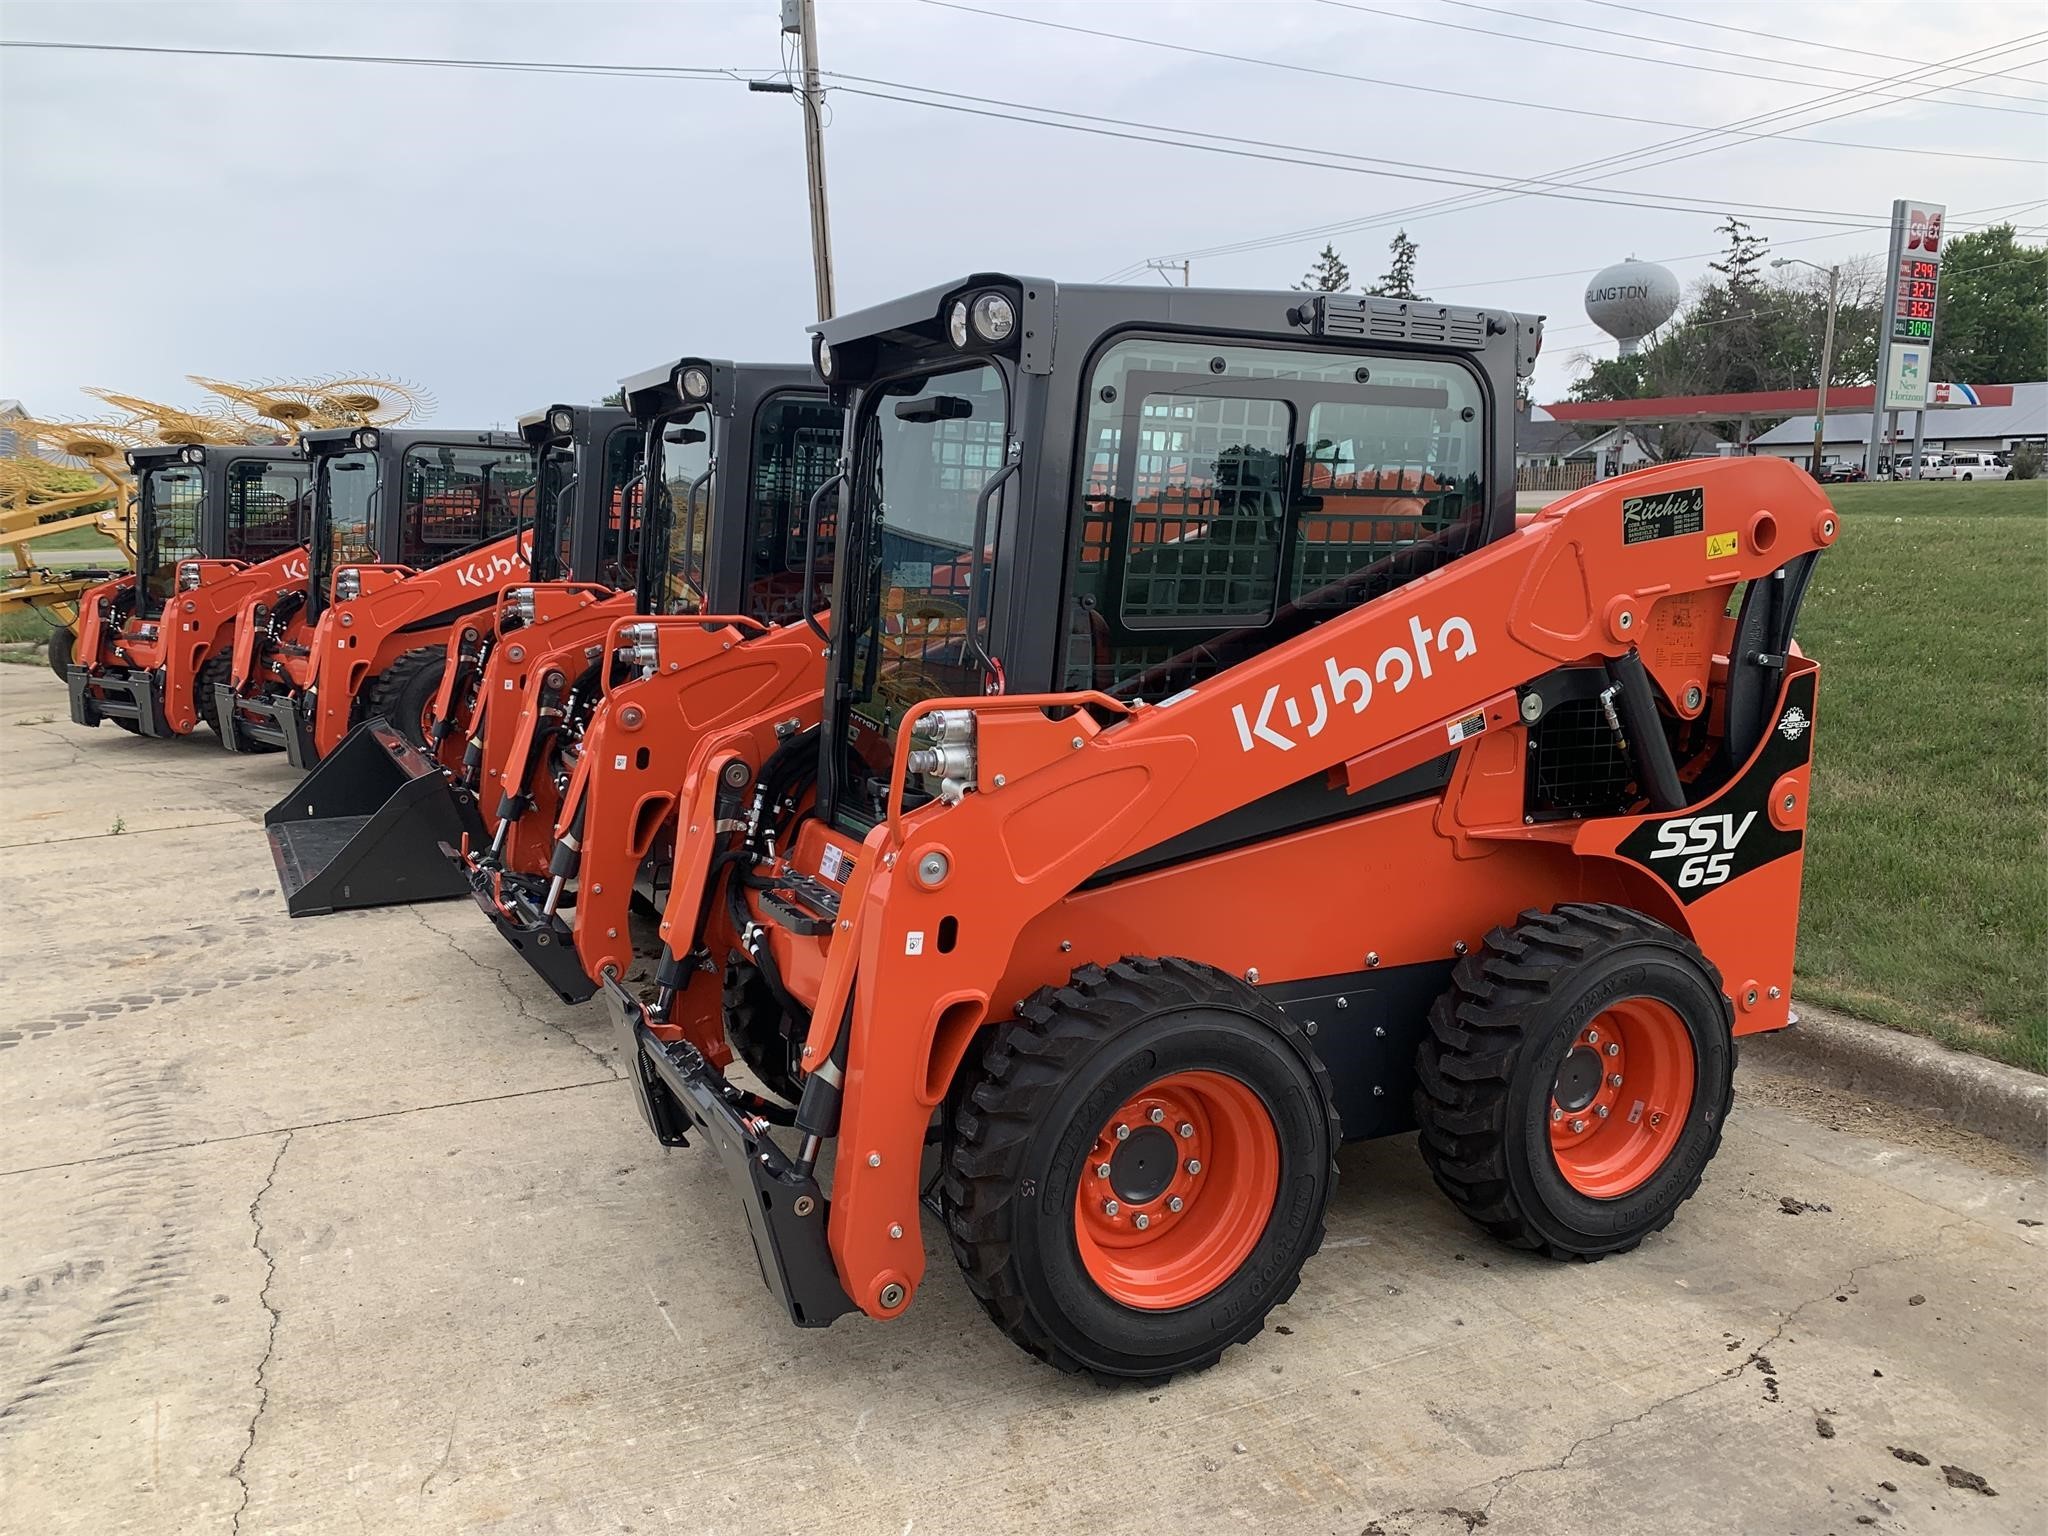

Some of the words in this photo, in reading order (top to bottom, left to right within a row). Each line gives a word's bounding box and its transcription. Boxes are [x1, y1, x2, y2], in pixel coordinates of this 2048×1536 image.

[1900, 380, 1917, 390] New
[1624, 490, 1703, 524] Ritchie's
[1232, 615, 1477, 752] Kubota
[1650, 811, 1758, 859] SSV
[1678, 852, 1734, 888] 65
